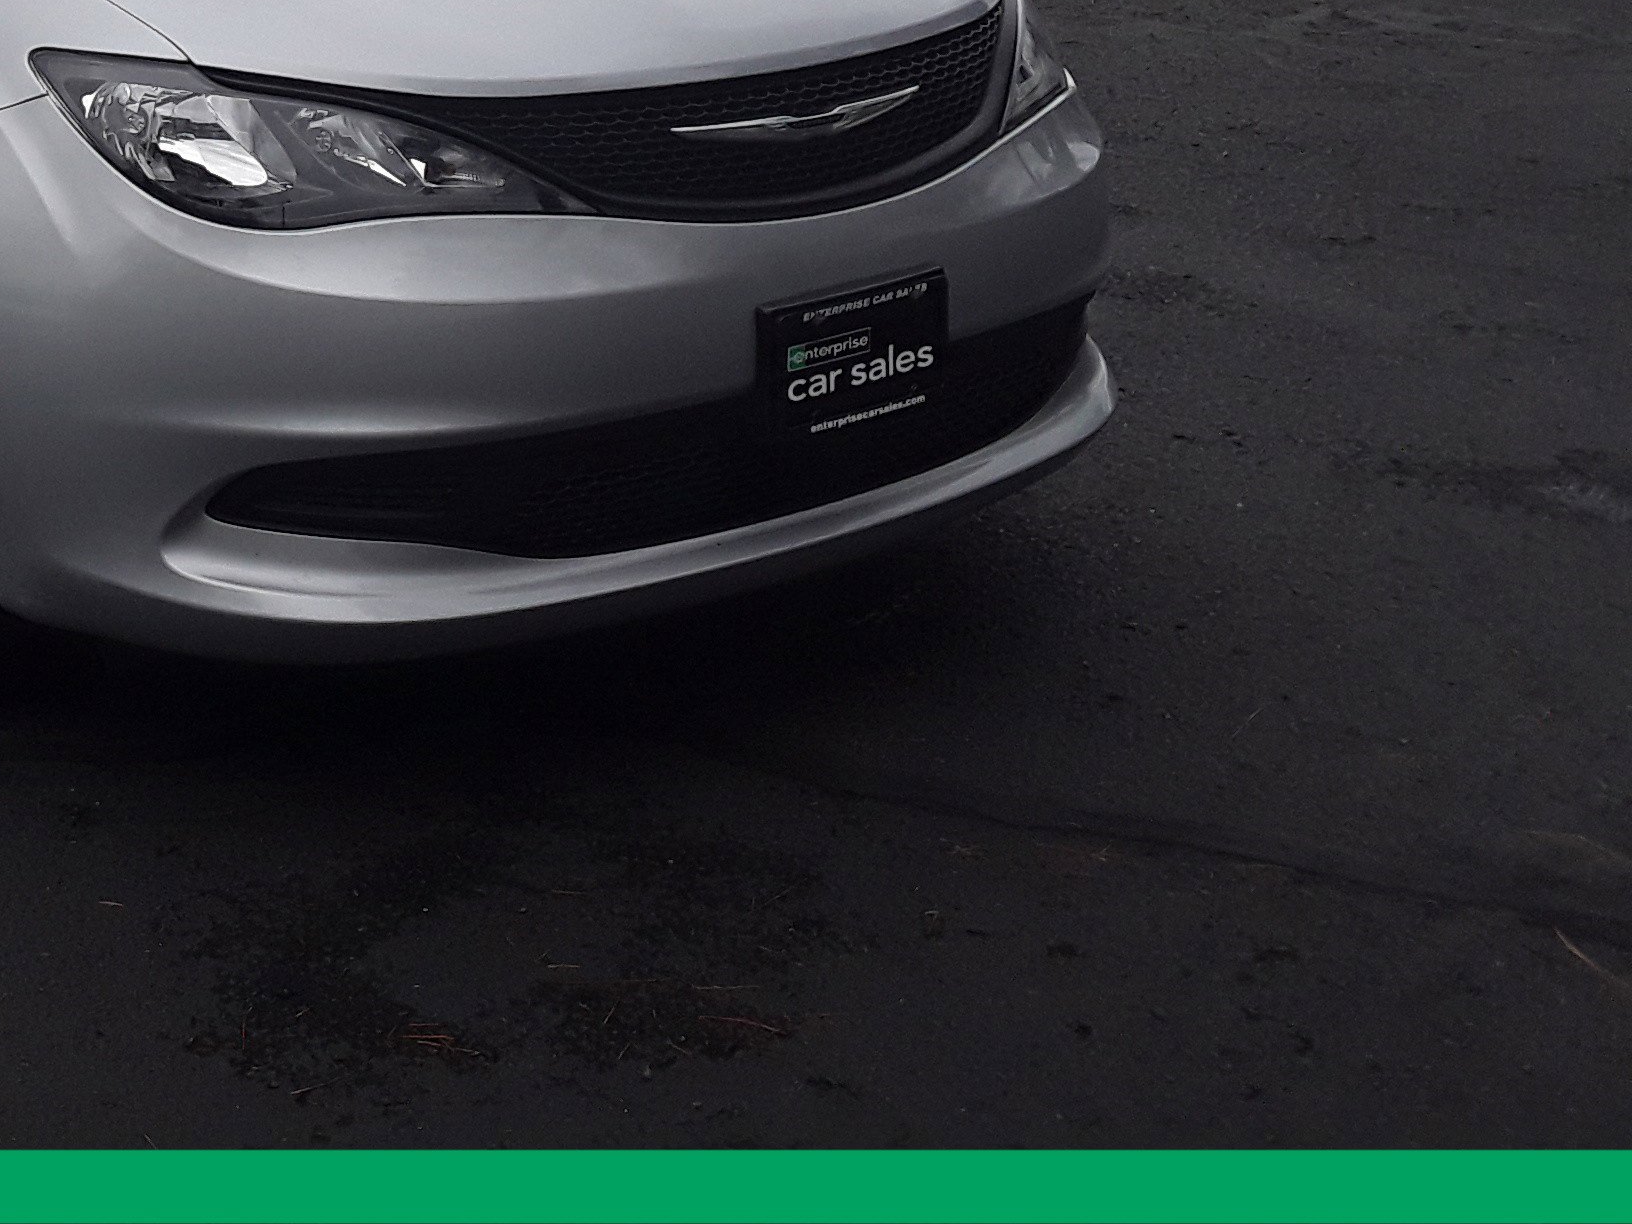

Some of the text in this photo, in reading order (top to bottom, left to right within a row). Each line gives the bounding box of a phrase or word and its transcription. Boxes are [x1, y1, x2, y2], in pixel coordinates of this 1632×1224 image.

[872, 291, 894, 306] CAR
[791, 335, 868, 364] enterprise
[787, 344, 934, 402] car sales
[810, 394, 926, 433] enterprisecarsales.com
